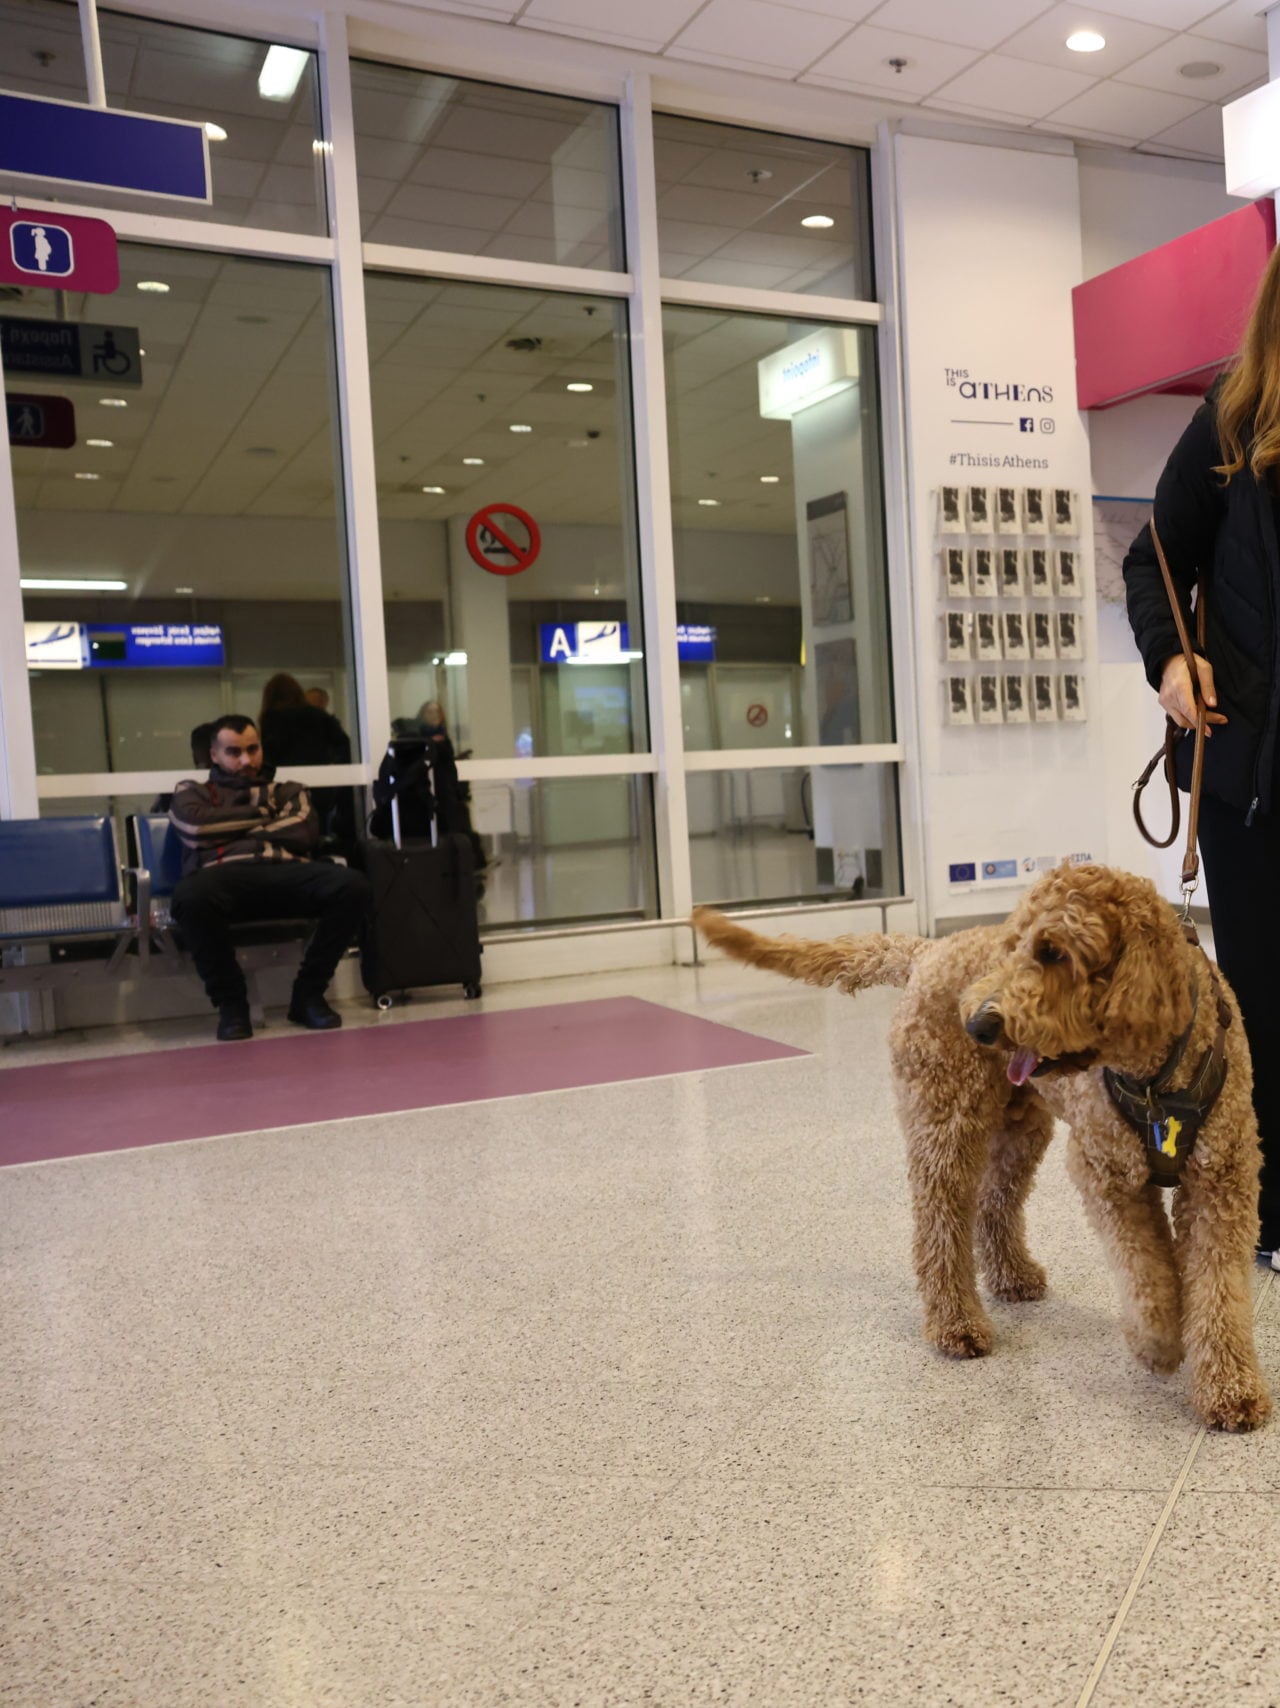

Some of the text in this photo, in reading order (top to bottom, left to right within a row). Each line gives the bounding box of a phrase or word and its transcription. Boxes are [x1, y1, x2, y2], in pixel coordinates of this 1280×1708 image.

[944, 368, 970, 379] THIS
[946, 377, 957, 387] IS
[549, 628, 572, 658] A
